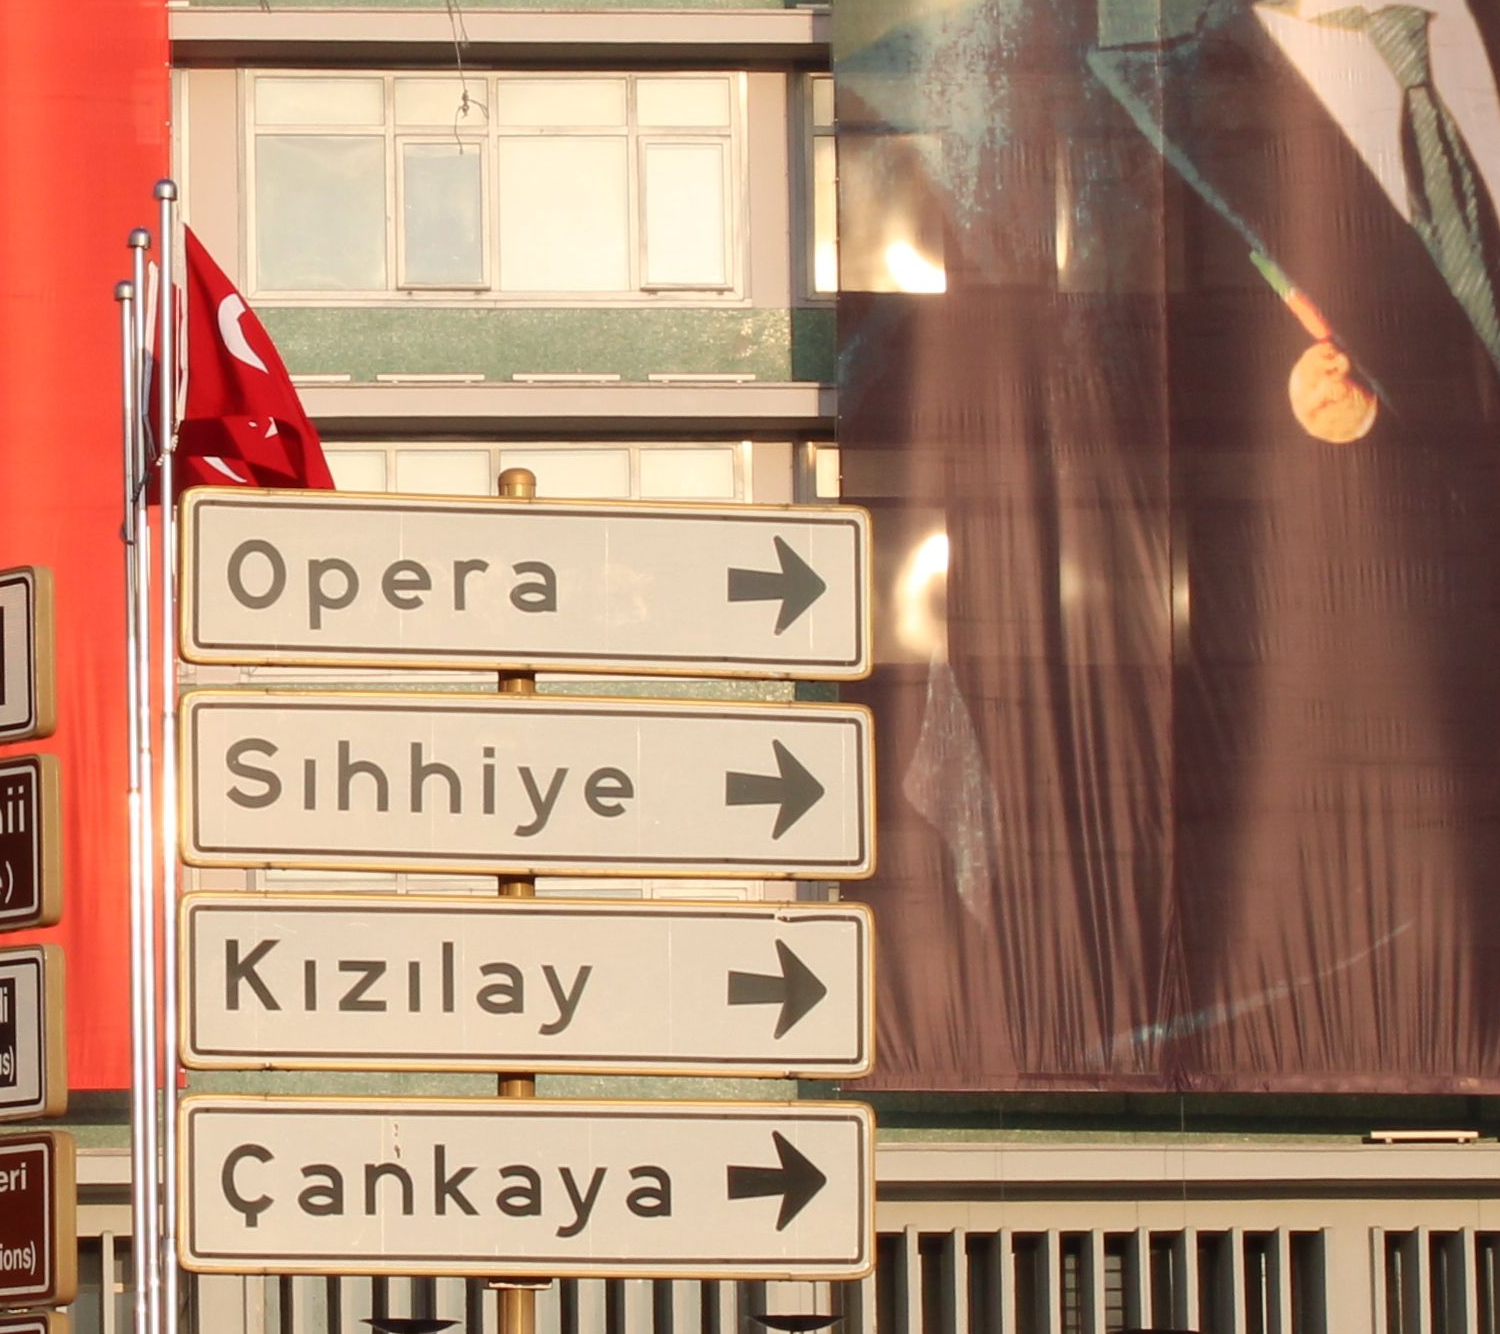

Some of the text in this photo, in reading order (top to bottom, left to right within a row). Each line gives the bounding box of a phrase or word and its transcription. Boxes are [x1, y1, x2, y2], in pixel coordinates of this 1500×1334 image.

[227, 539, 560, 631] Opera
[225, 738, 636, 837] Sıhhiye
[223, 938, 593, 1037] Kızılay
[220, 1142, 674, 1238] Çankaya
